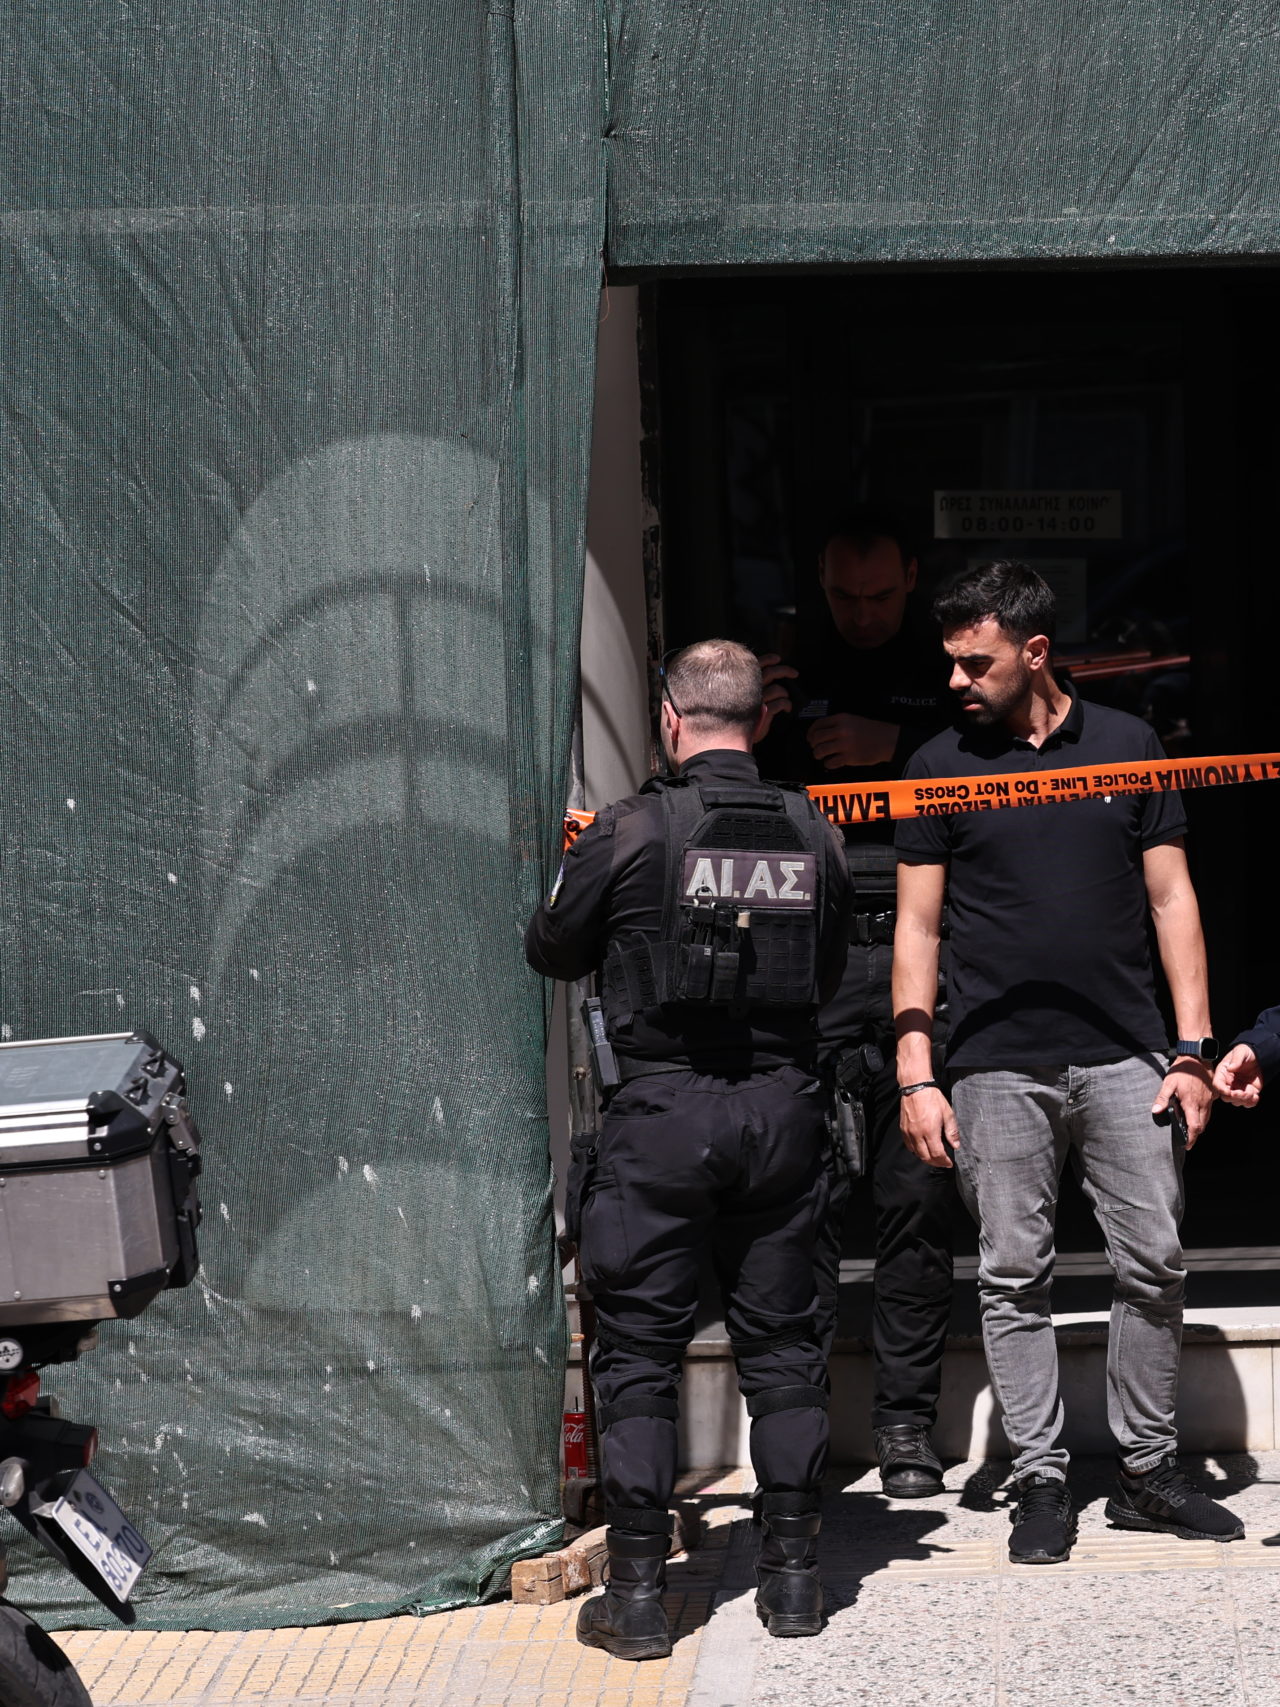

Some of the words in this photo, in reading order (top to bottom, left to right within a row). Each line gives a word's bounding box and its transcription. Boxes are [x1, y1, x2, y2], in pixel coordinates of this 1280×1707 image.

[961, 516, 1095, 532] 08:00-14:00
[888, 695, 936, 707] POLICE
[1014, 779, 1039, 795] DO
[1051, 776, 1088, 791] LINE
[1094, 771, 1151, 787] POLICE
[914, 784, 970, 801] CROSS
[974, 781, 1009, 797] NOT
